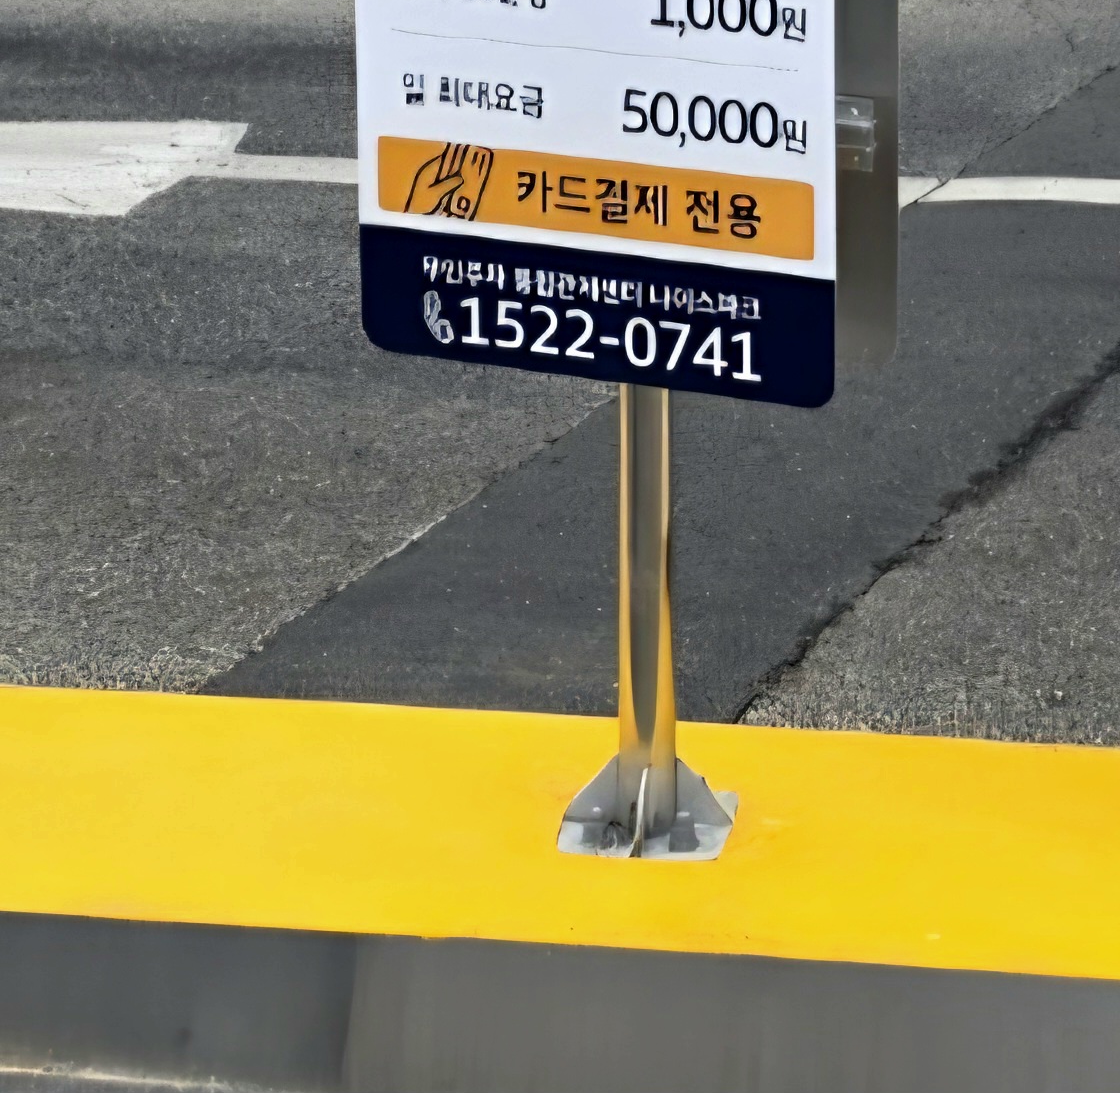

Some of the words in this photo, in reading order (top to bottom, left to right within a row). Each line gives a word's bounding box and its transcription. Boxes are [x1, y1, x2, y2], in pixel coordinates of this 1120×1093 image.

[516, 169, 669, 227] 카드결제
[685, 189, 762, 240] 전용
[459, 297, 763, 382] 1522-0741
